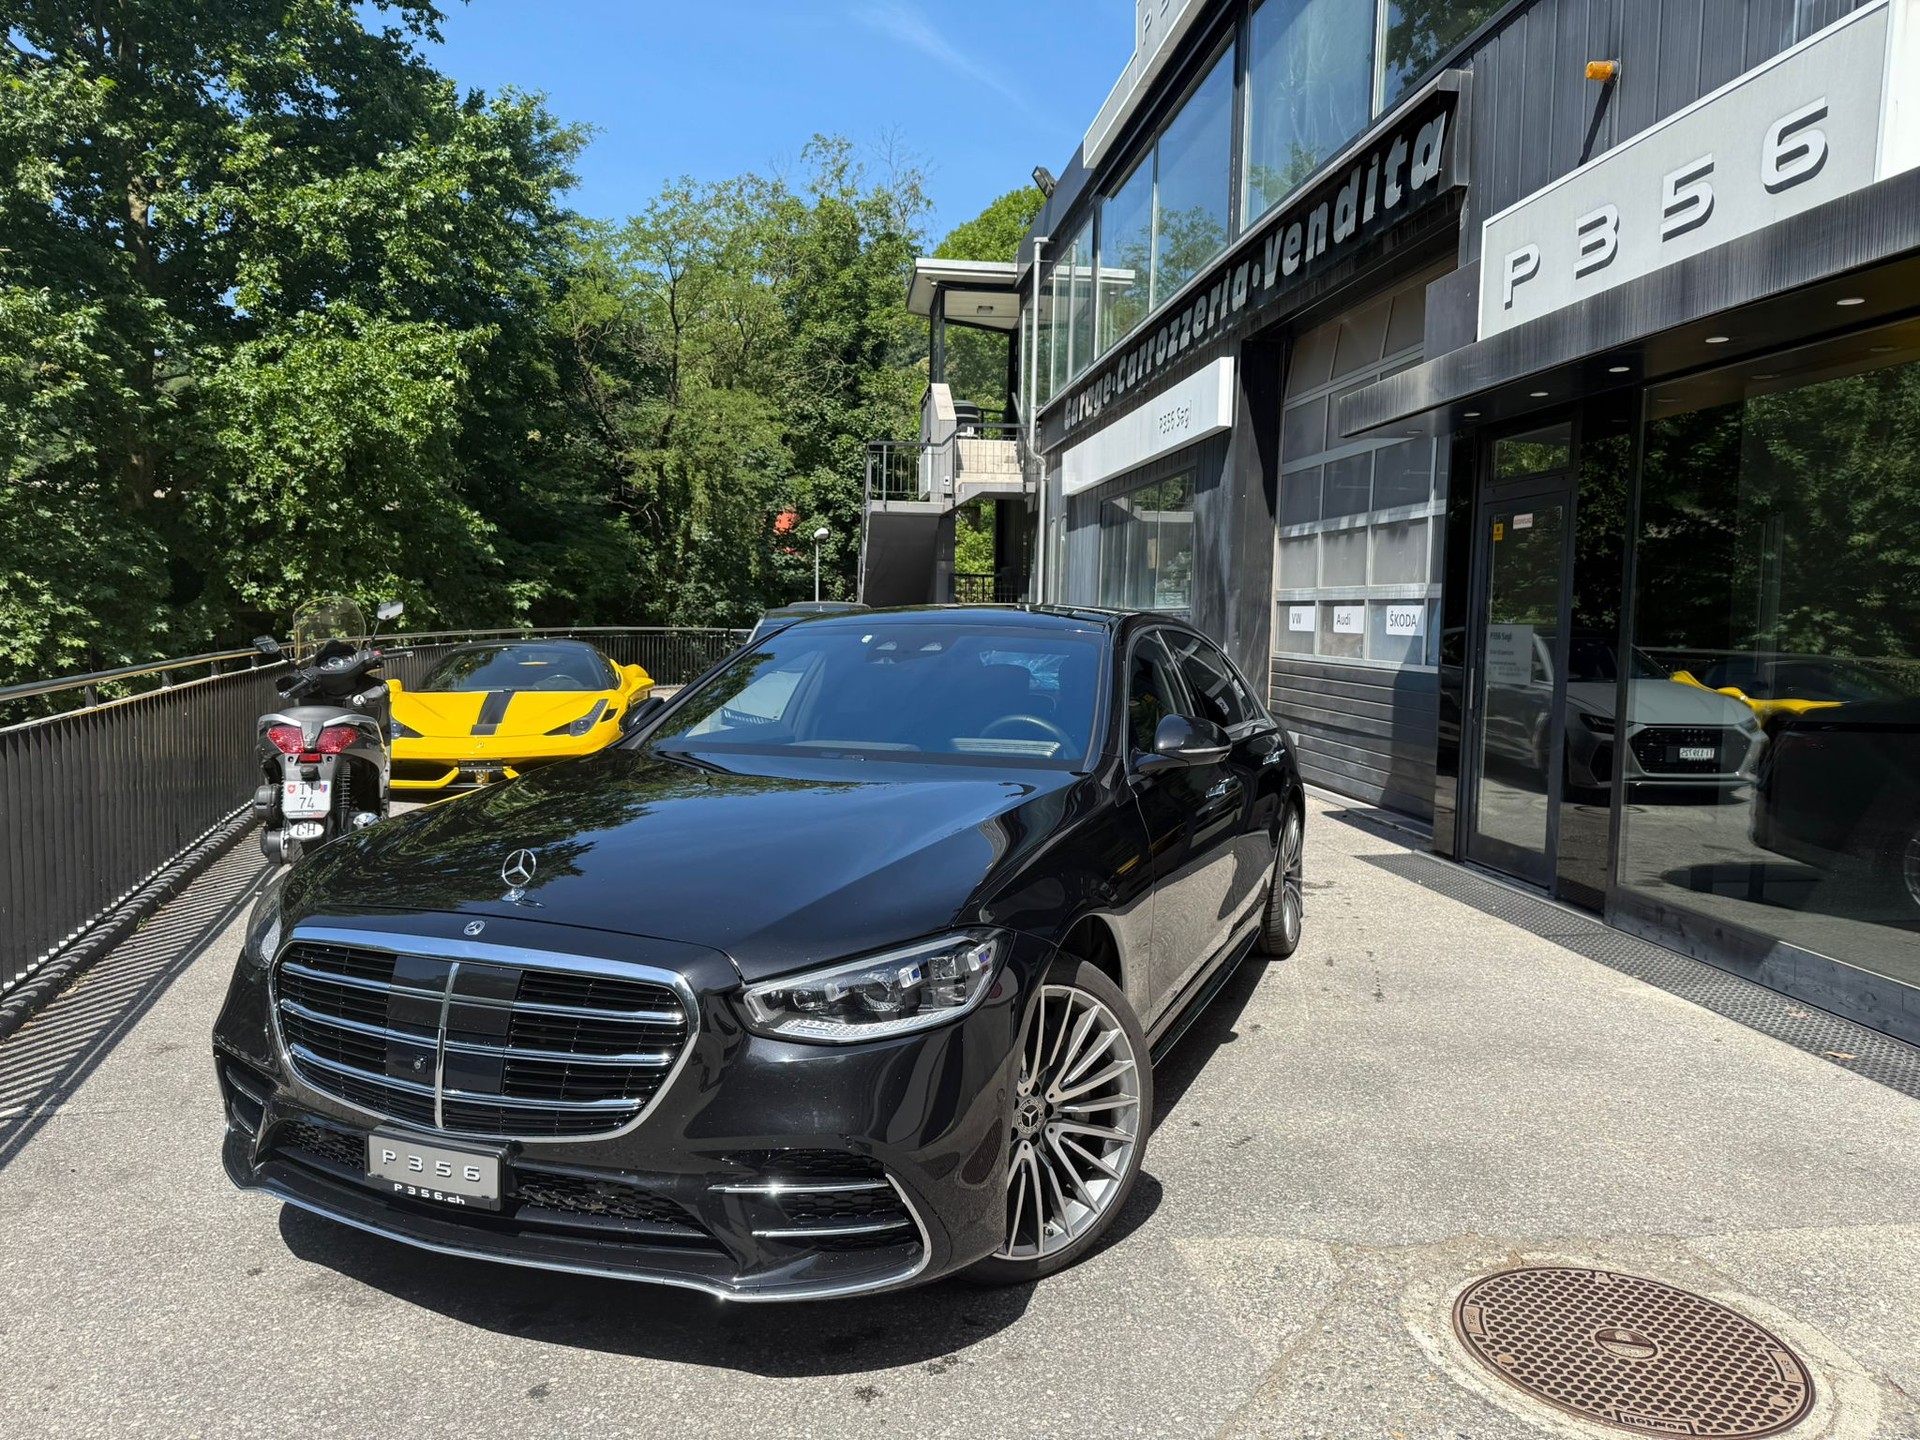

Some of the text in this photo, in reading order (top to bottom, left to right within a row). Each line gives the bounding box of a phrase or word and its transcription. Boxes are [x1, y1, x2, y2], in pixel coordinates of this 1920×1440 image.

[1064, 110, 1446, 430] Garage Carrozzeria Vendita
[1291, 612, 1302, 625] VW
[1336, 613, 1352, 626] Audi
[1389, 610, 1418, 628] ŠKODA
[299, 796, 315, 809] 74
[296, 822, 316, 836] CH
